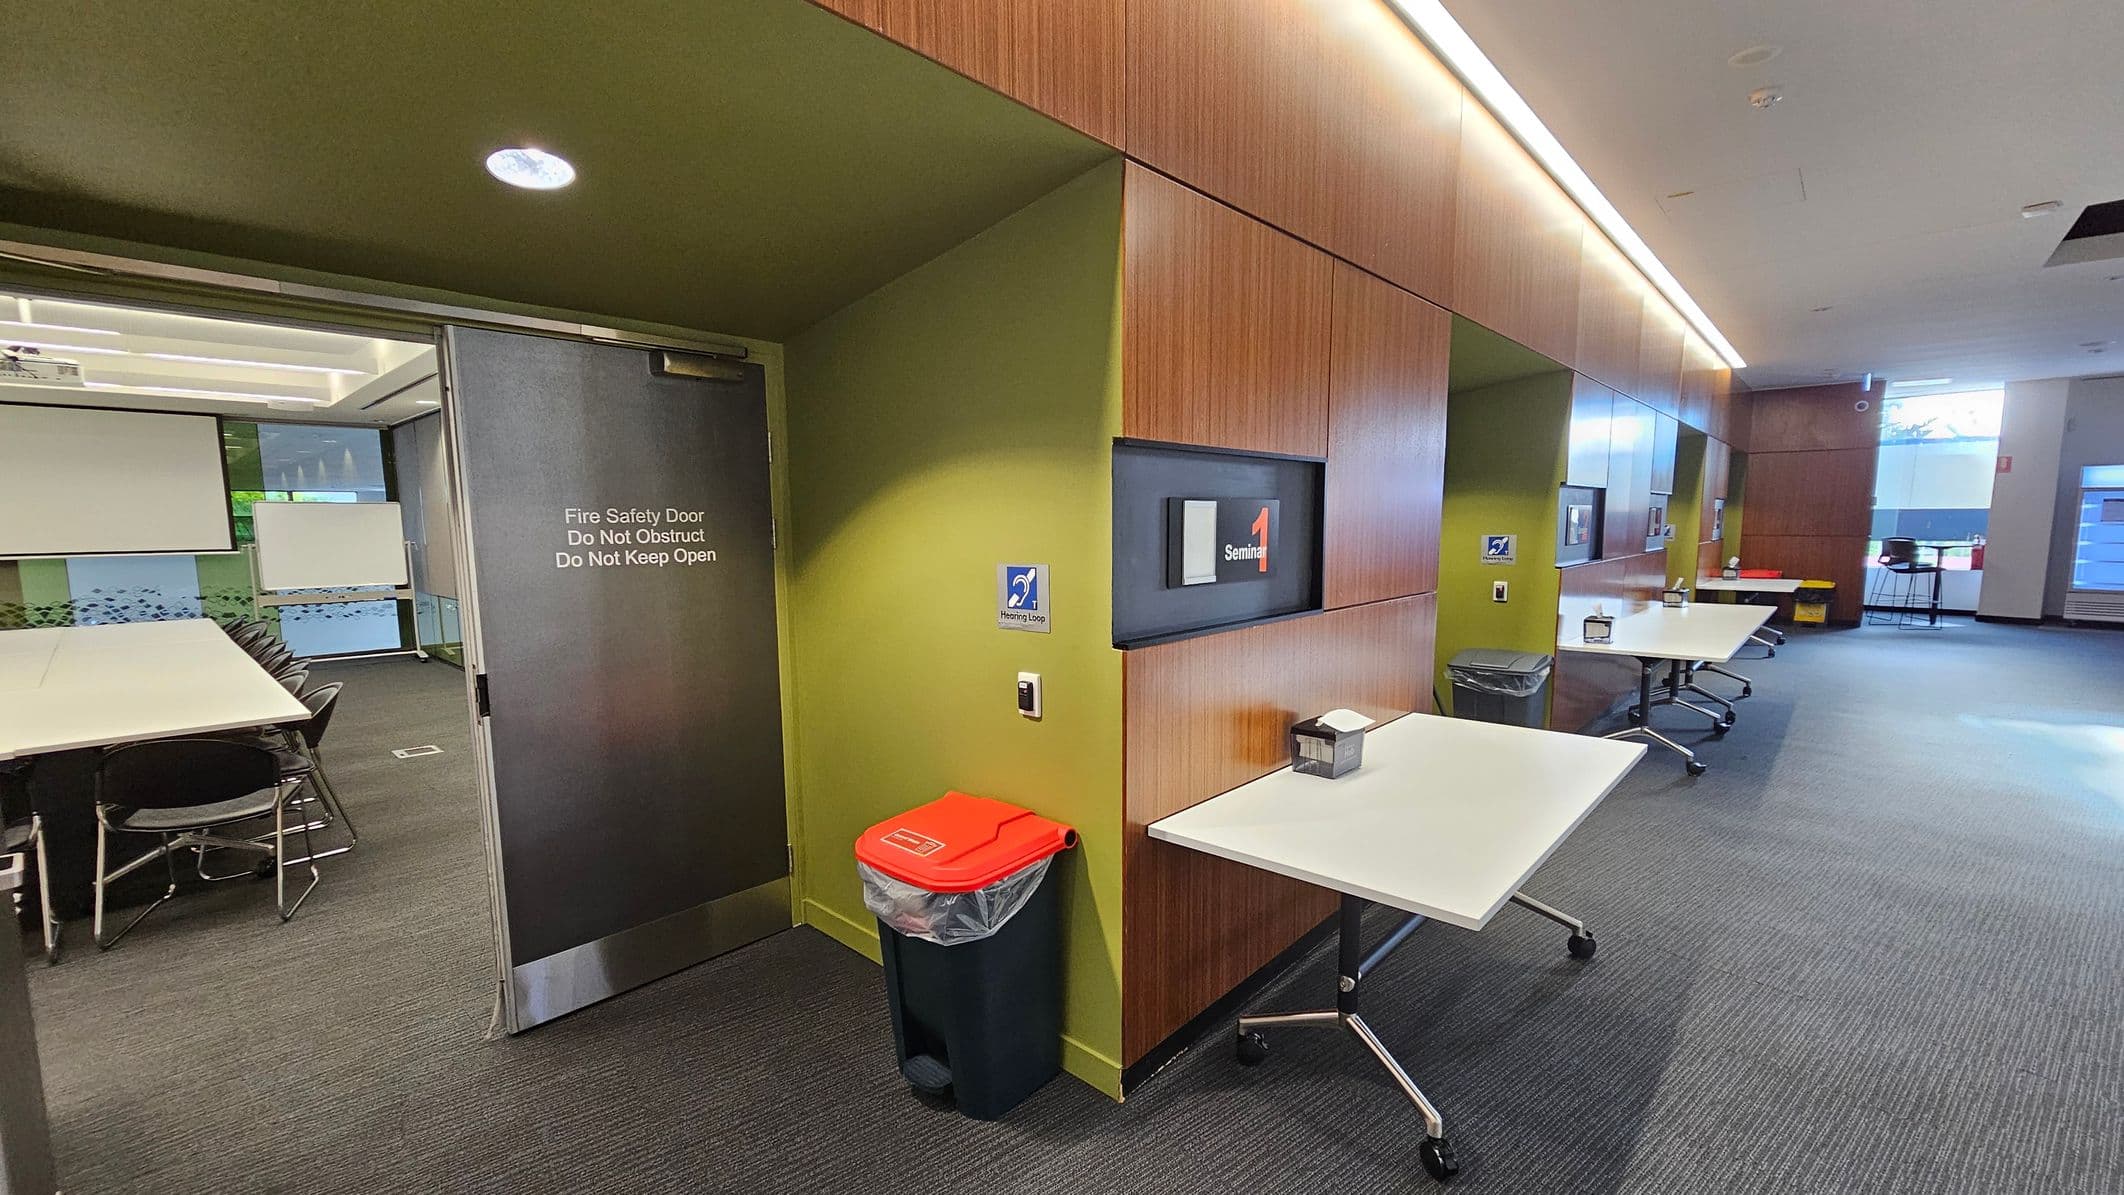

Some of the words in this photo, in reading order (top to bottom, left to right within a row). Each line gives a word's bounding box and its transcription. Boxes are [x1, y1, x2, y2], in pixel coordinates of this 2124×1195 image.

[565, 508, 600, 524] Fire
[606, 508, 661, 526] Safety
[666, 508, 704, 523] Door
[567, 530, 594, 546] Do
[600, 529, 631, 545] Not
[636, 528, 705, 544] Obstruct
[1251, 507, 1269, 572] 1
[556, 552, 583, 568] Do
[589, 551, 620, 566] Not
[625, 550, 669, 567] Keep
[674, 548, 716, 564] Open
[1224, 543, 1267, 561] Seminar
[1032, 600, 1037, 609] T
[1000, 610, 1027, 622] Hearing
[1028, 613, 1046, 624] Loop
